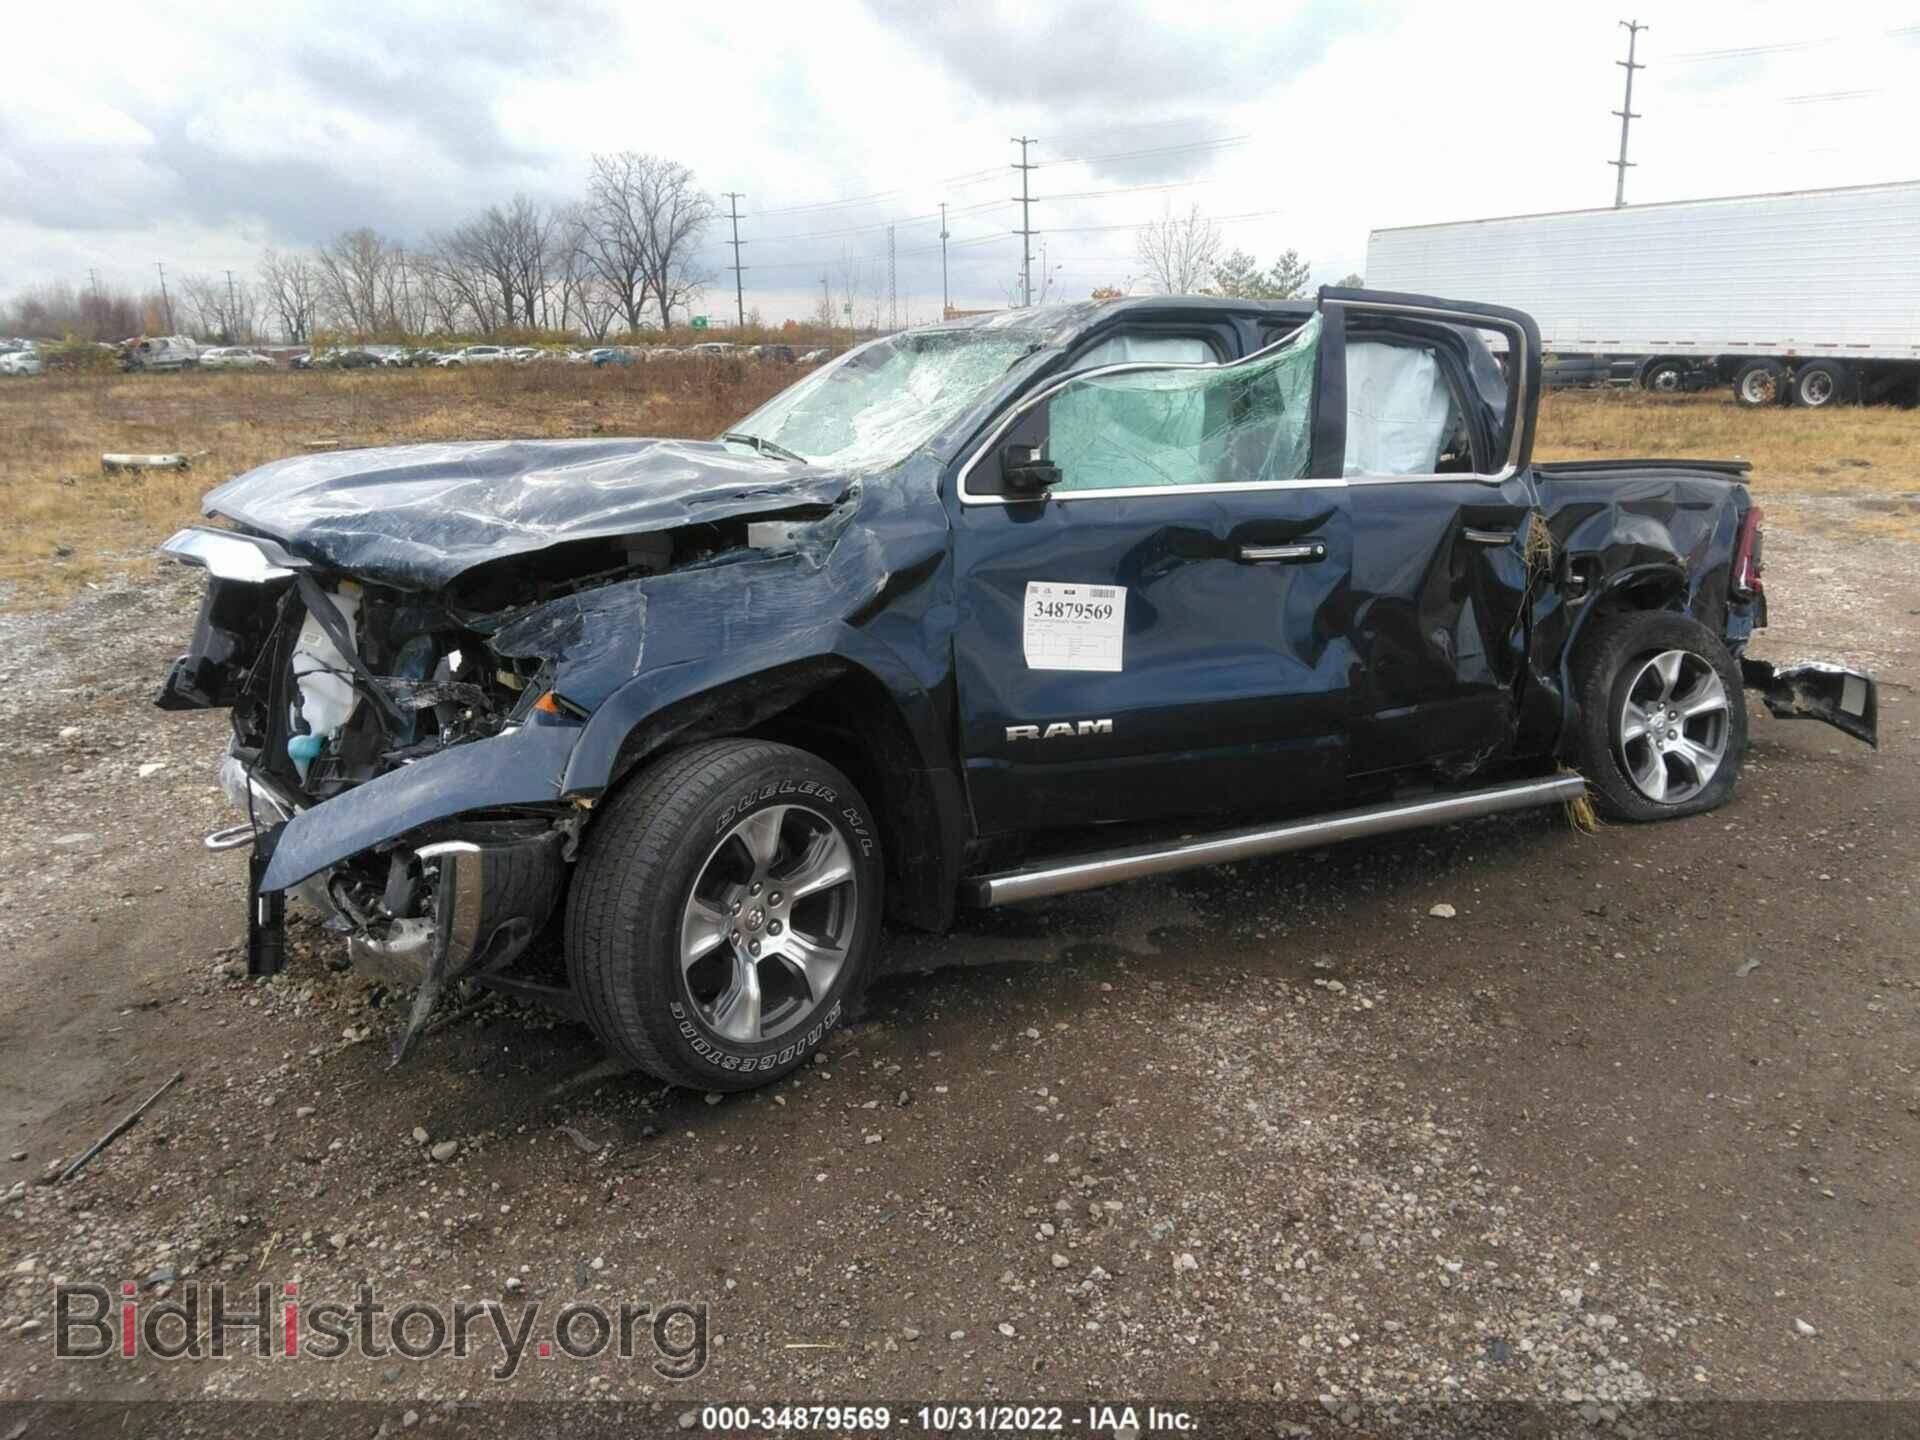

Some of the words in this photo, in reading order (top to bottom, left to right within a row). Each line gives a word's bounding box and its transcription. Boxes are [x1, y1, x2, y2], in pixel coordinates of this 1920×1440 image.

[1033, 600, 1113, 620] 34879569
[1005, 719, 1113, 741] RAM
[716, 779, 838, 834] DUELER
[842, 808, 873, 857] H/L
[670, 999, 841, 1072] BRIDGESTONE
